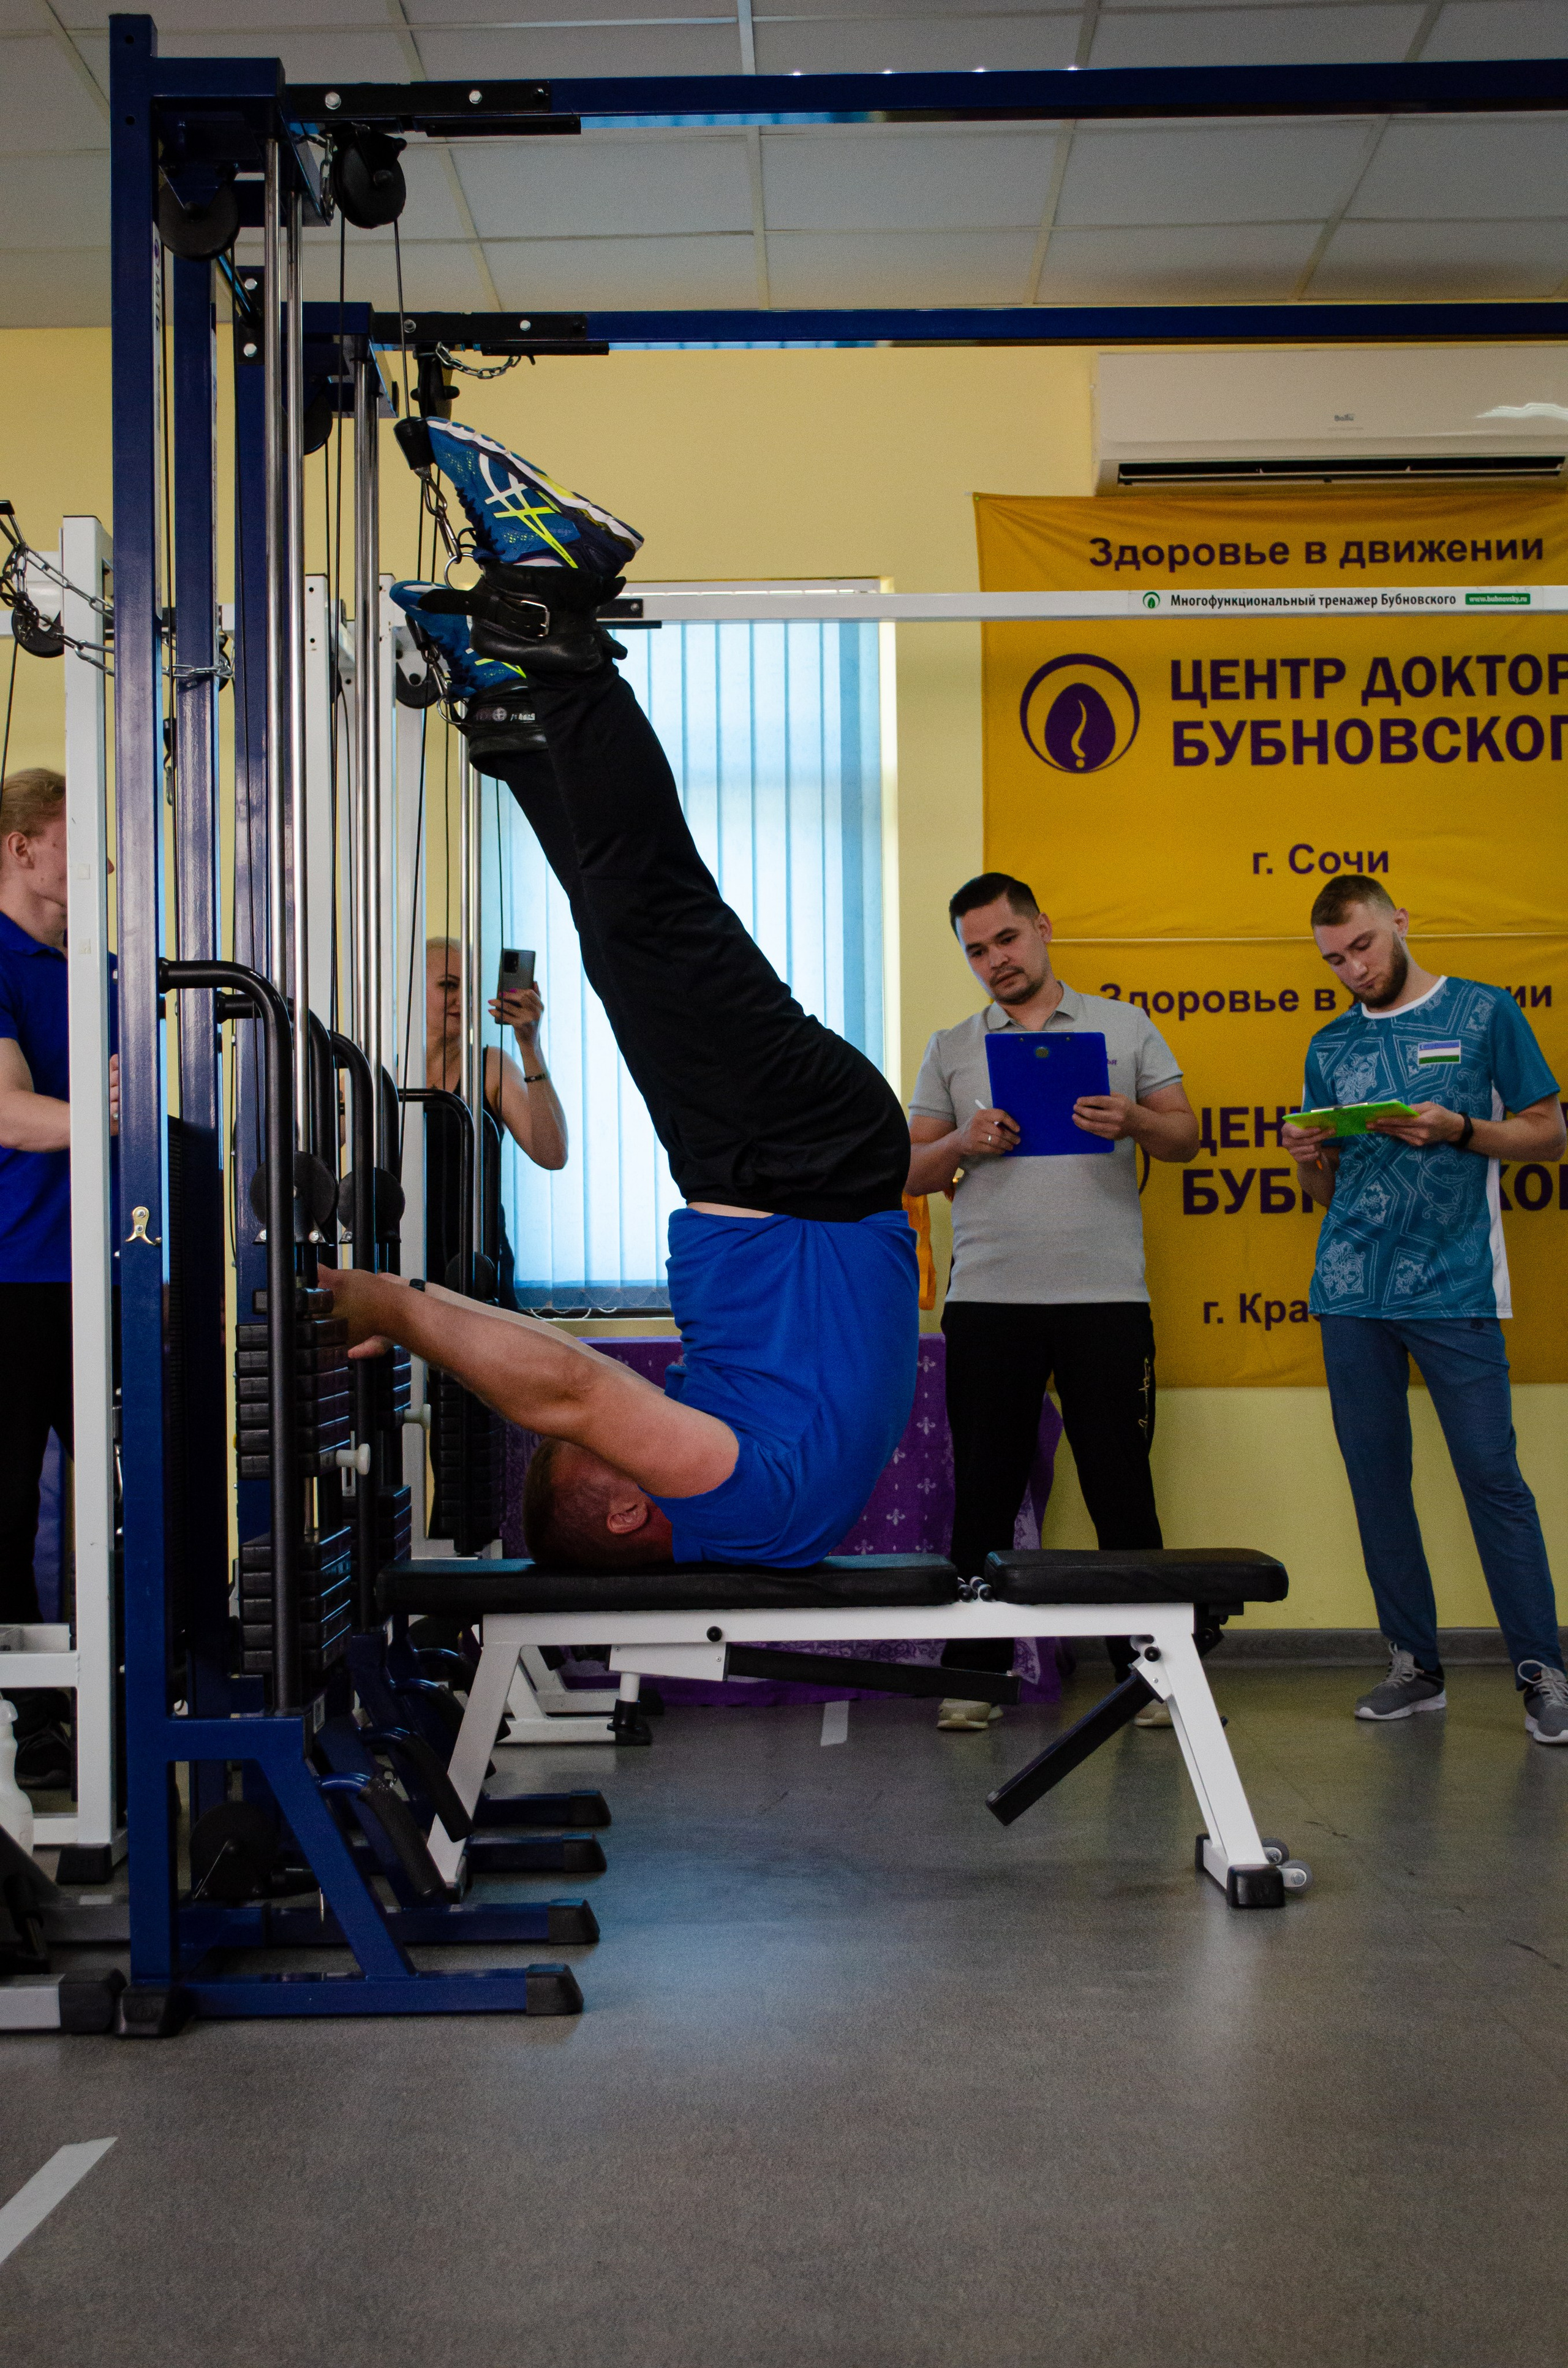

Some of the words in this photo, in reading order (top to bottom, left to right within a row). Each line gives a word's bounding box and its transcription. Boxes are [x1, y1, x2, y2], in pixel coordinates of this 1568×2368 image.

[1089, 537, 1290, 573] Здоровье
[1305, 541, 1327, 564] в
[1340, 538, 1544, 569] движении
[1170, 594, 1316, 609] Многофункциональный
[1319, 596, 1378, 608] тренажер
[1381, 593, 1456, 608] Бубновского
[1171, 657, 1346, 708] ЦЕНТР
[1253, 852, 1273, 874] г.
[1288, 843, 1389, 874] Сочи
[1314, 988, 1336, 1011] в
[1204, 1301, 1224, 1324] г.
[1240, 1292, 1320, 1331] Кра
